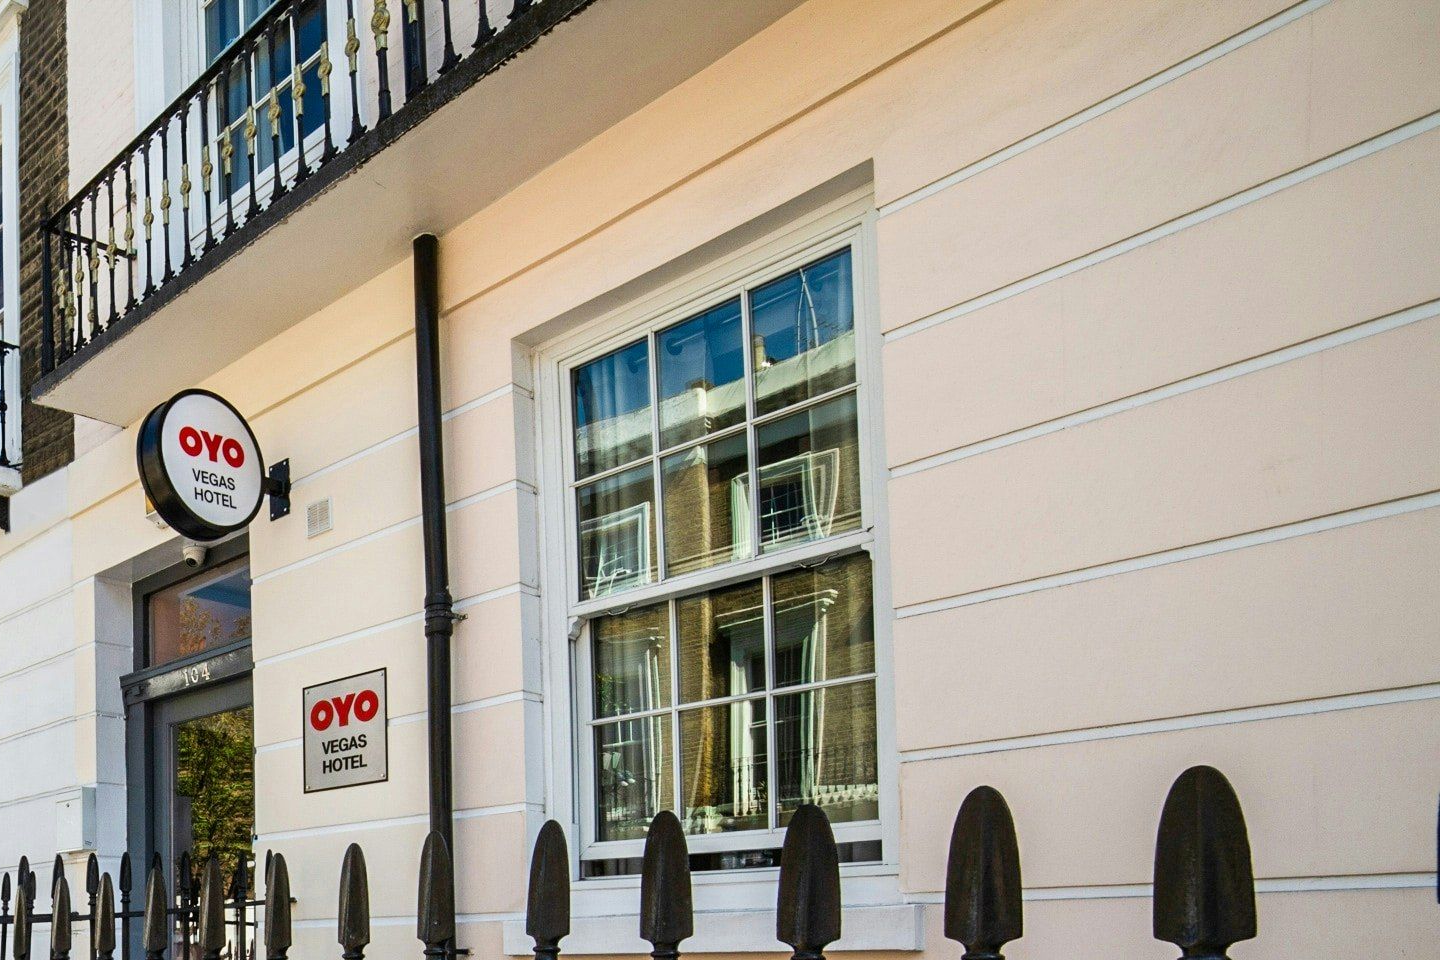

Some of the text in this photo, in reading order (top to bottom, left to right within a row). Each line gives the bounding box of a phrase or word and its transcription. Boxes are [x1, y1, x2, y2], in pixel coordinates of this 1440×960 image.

[179, 426, 245, 468] OYO
[192, 468, 236, 491] VEGAS
[194, 487, 237, 509] HOTEL
[182, 661, 210, 687] 104
[310, 690, 378, 731] OYO
[322, 734, 367, 754] VEGAS
[322, 754, 367, 774] HOTEL
